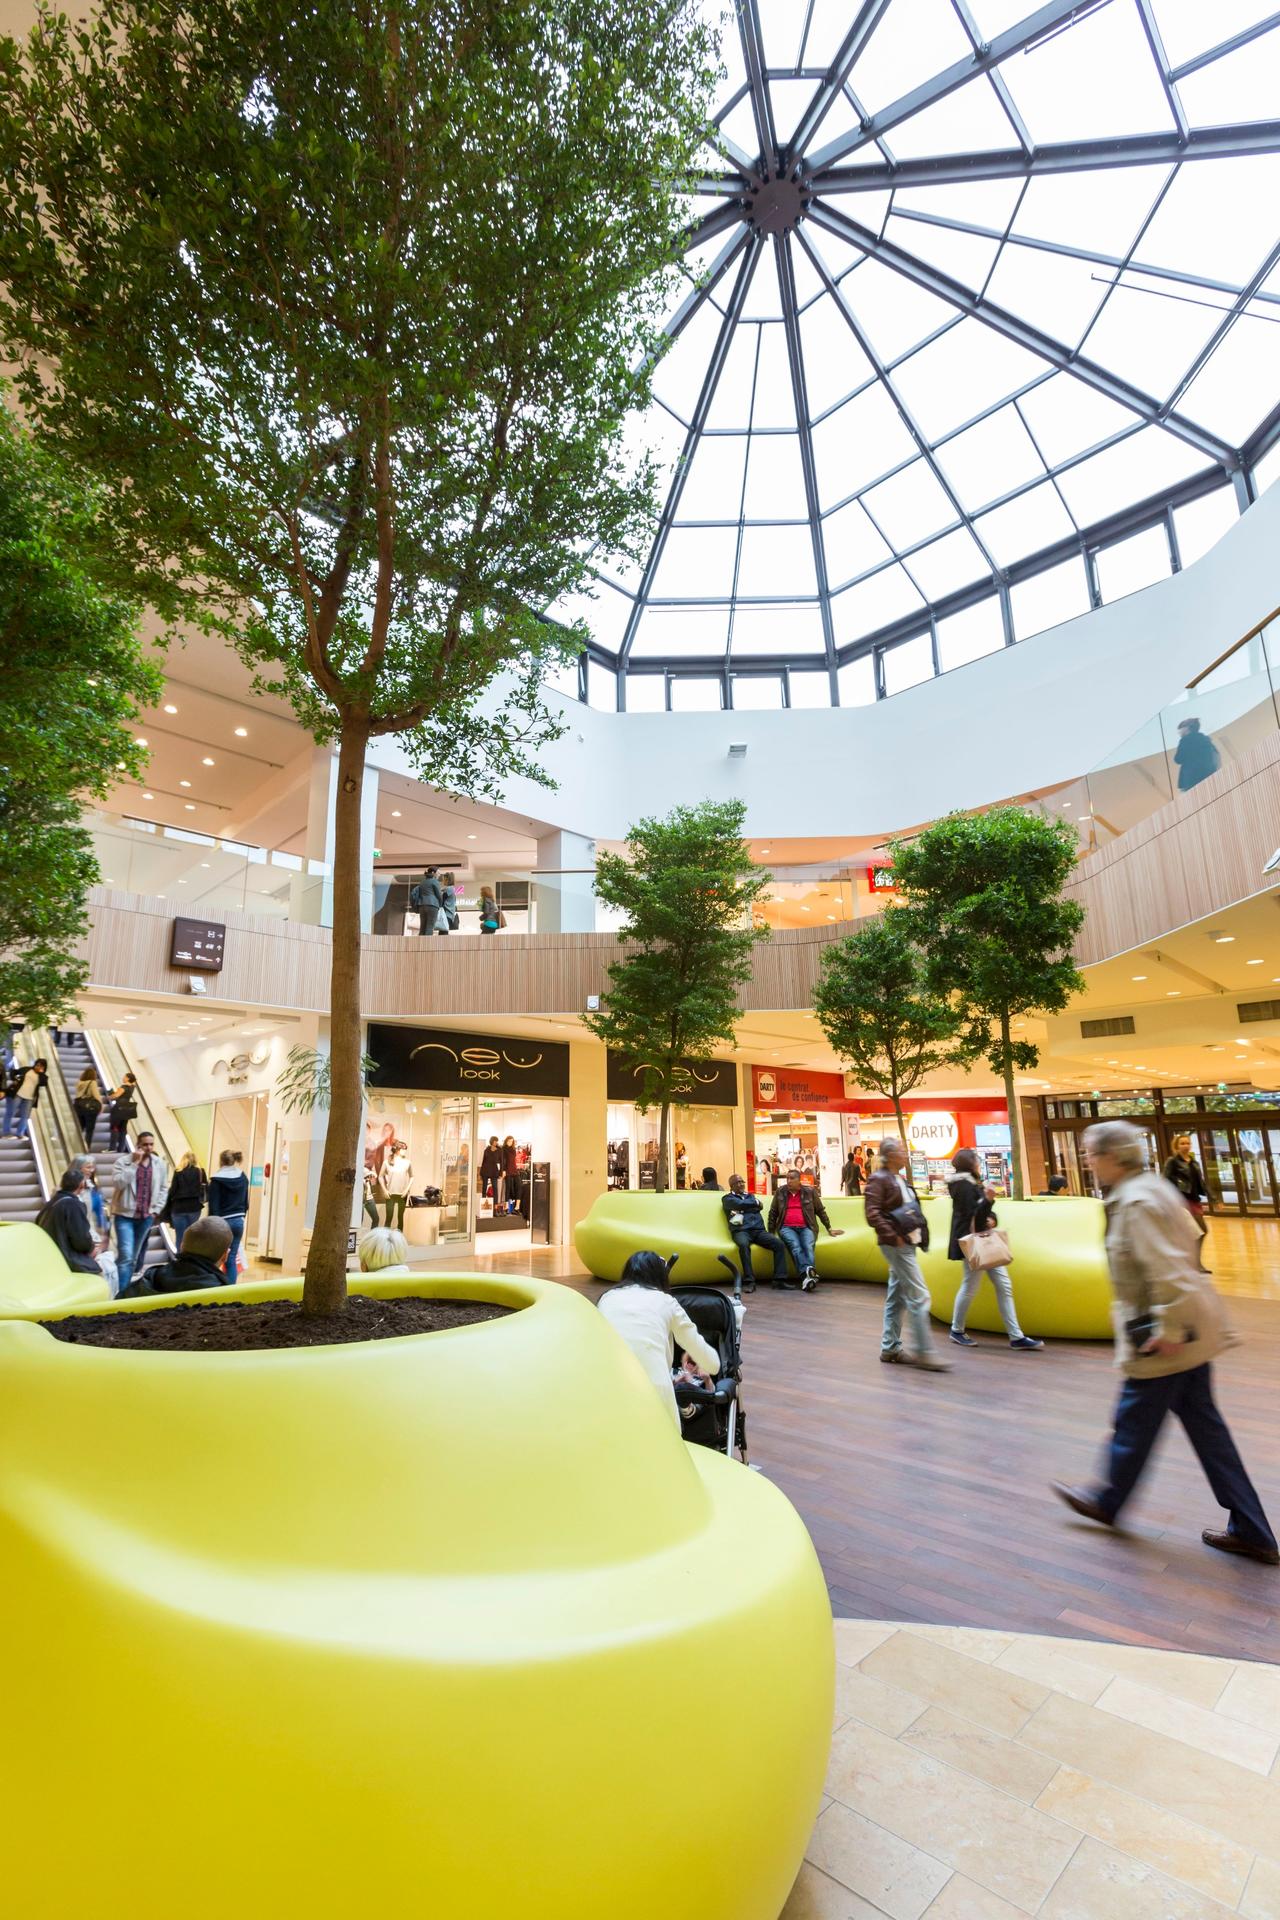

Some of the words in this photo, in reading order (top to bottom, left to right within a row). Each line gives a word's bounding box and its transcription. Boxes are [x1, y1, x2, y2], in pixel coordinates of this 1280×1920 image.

[460, 1067, 500, 1080] look
[669, 1084, 692, 1093] ook
[759, 1082, 775, 1092] DARTY
[792, 1092, 800, 1102] de
[801, 1093, 829, 1103] confiance
[911, 1124, 954, 1139] DARTY
